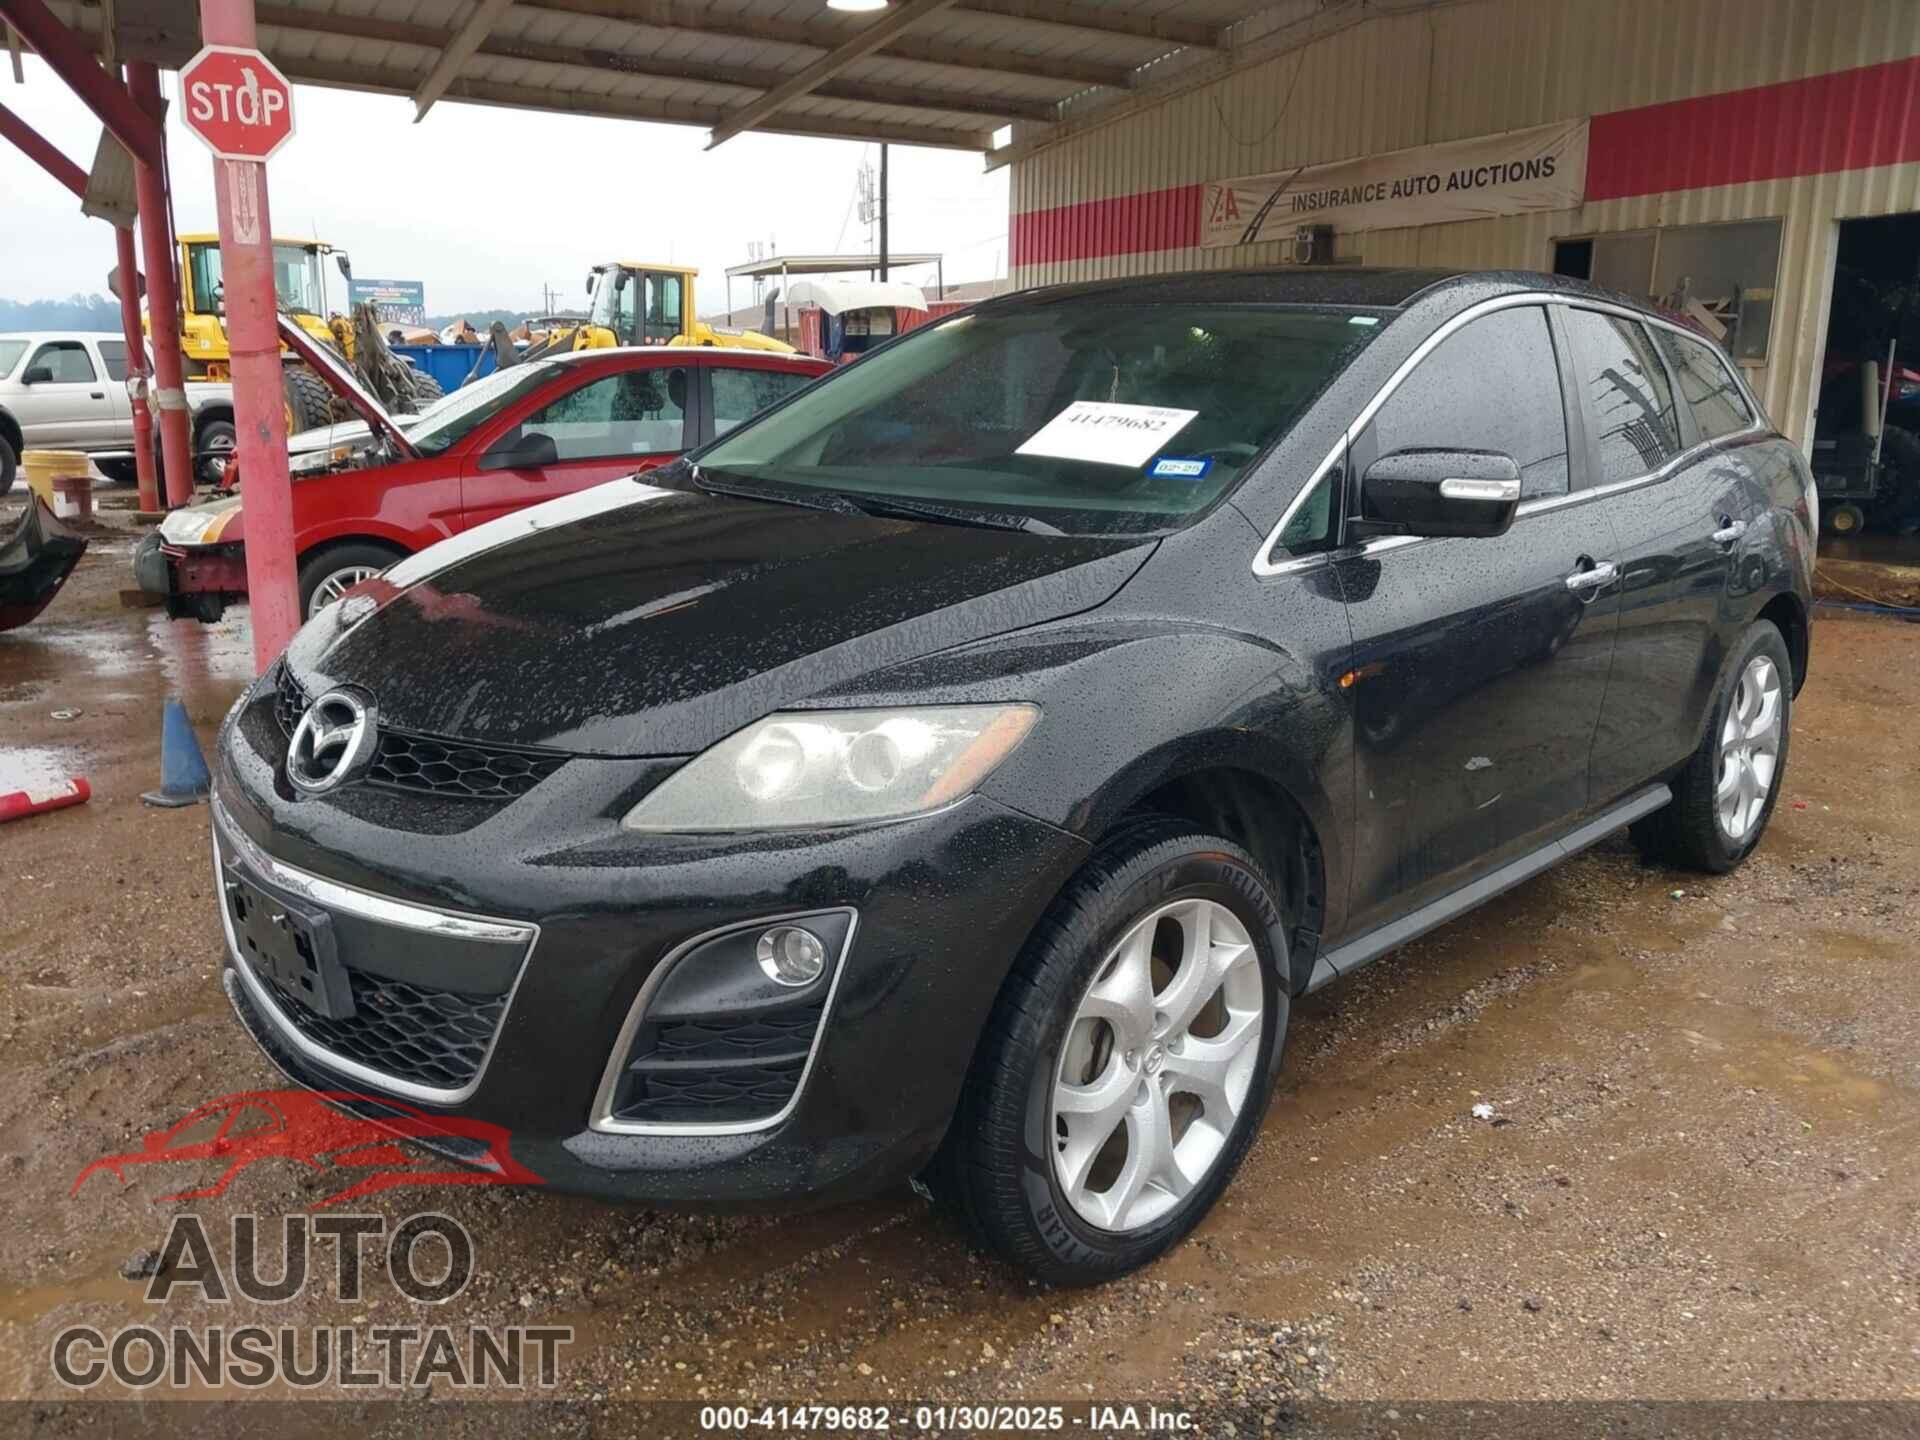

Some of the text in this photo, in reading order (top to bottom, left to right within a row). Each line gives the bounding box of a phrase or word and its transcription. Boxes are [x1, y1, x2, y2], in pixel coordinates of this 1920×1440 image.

[190, 81, 284, 126] STOP
[1291, 156, 1556, 213] INSURANCE AUTO AUCTIONS
[1068, 413, 1167, 432] 41479682
[1221, 864, 1280, 929] RELIANT
